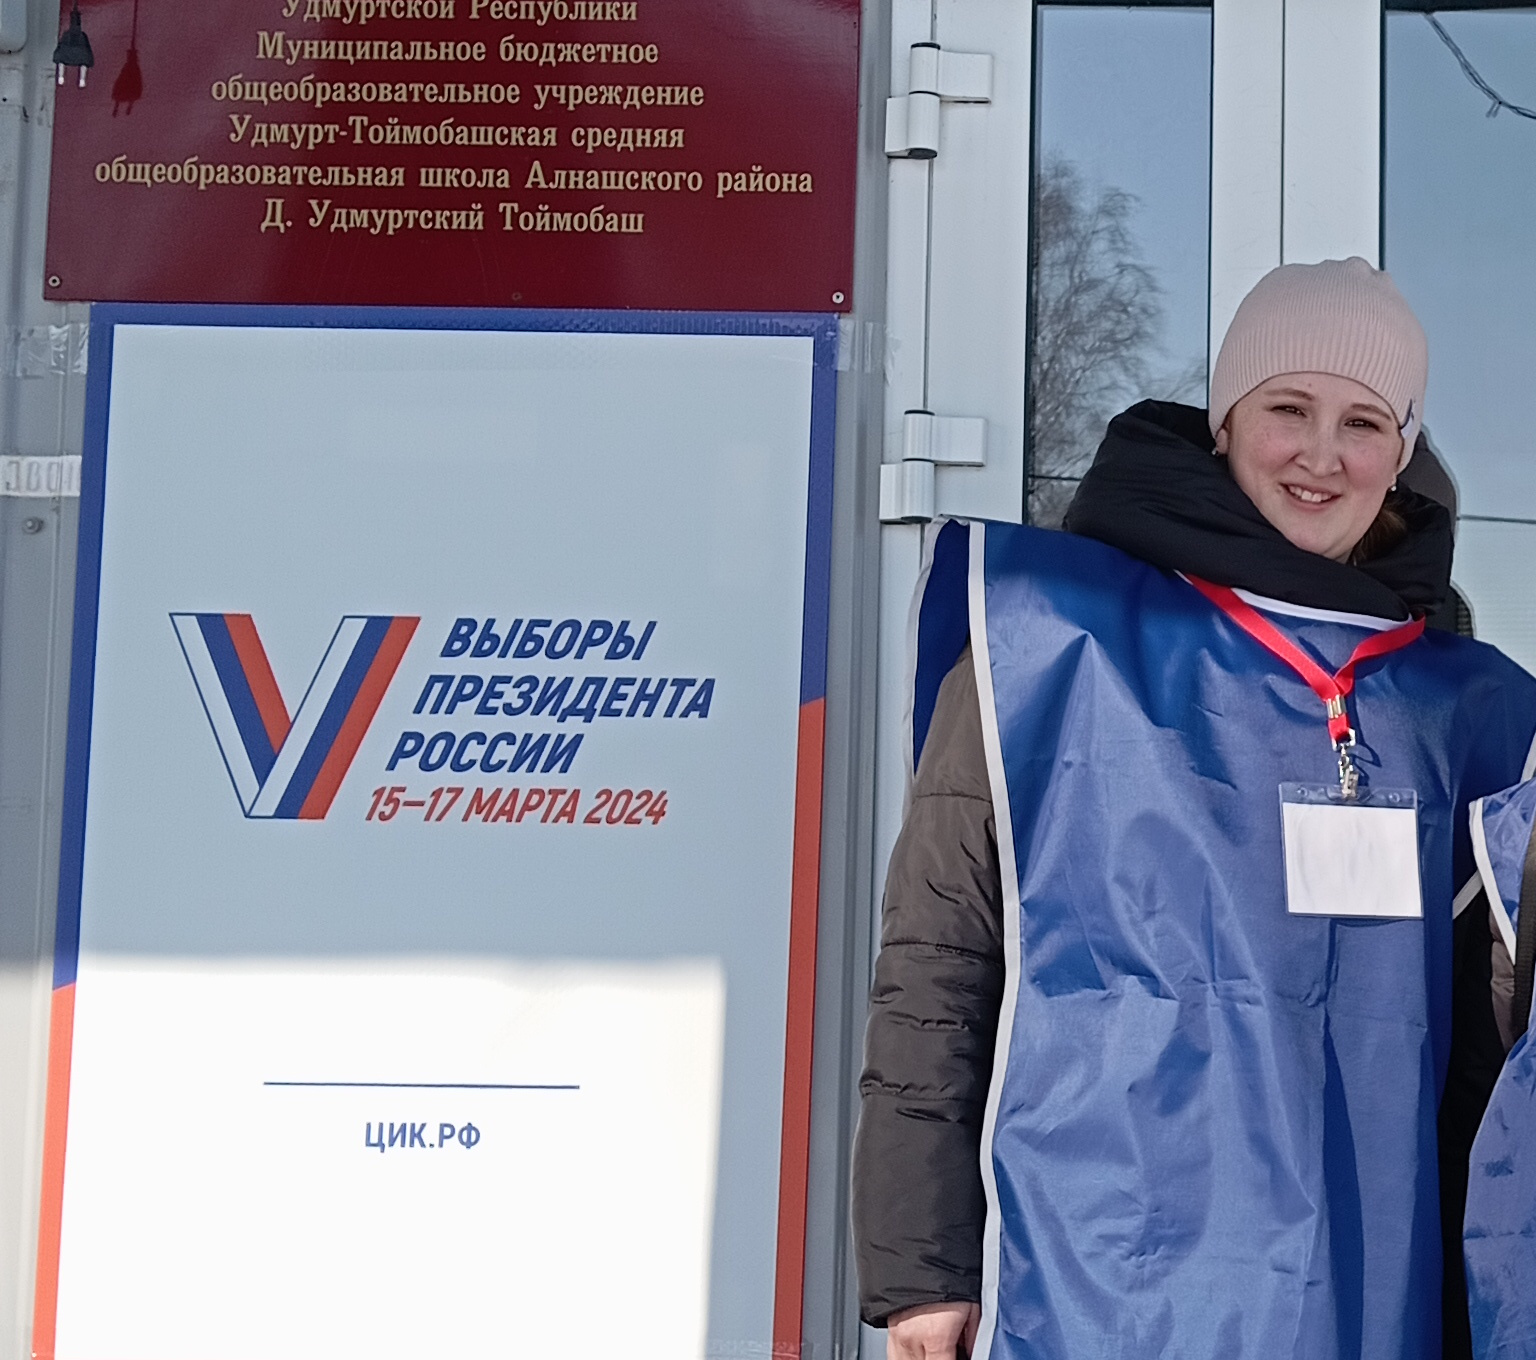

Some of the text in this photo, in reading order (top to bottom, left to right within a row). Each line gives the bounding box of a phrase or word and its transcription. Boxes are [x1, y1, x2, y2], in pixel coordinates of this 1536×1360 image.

[256, 31, 658, 67] Муниципальное бюджетное
[212, 73, 704, 110] общеобразовательное учреждение
[228, 114, 684, 153] Удмурт-Тоймобашская средняя
[96, 155, 812, 198] общеобразовательная школа Алнашского района
[261, 199, 644, 235] Д. Удмуртский Тоймобаш
[440, 618, 657, 660] ВЫБОРЫ
[413, 675, 715, 723] ПРЕЗИДЕНТА
[385, 732, 584, 773] РОССИИ
[462, 788, 580, 823] МАРТА
[583, 789, 668, 825] 2024
[366, 1122, 480, 1153] ЦИК.РФ
